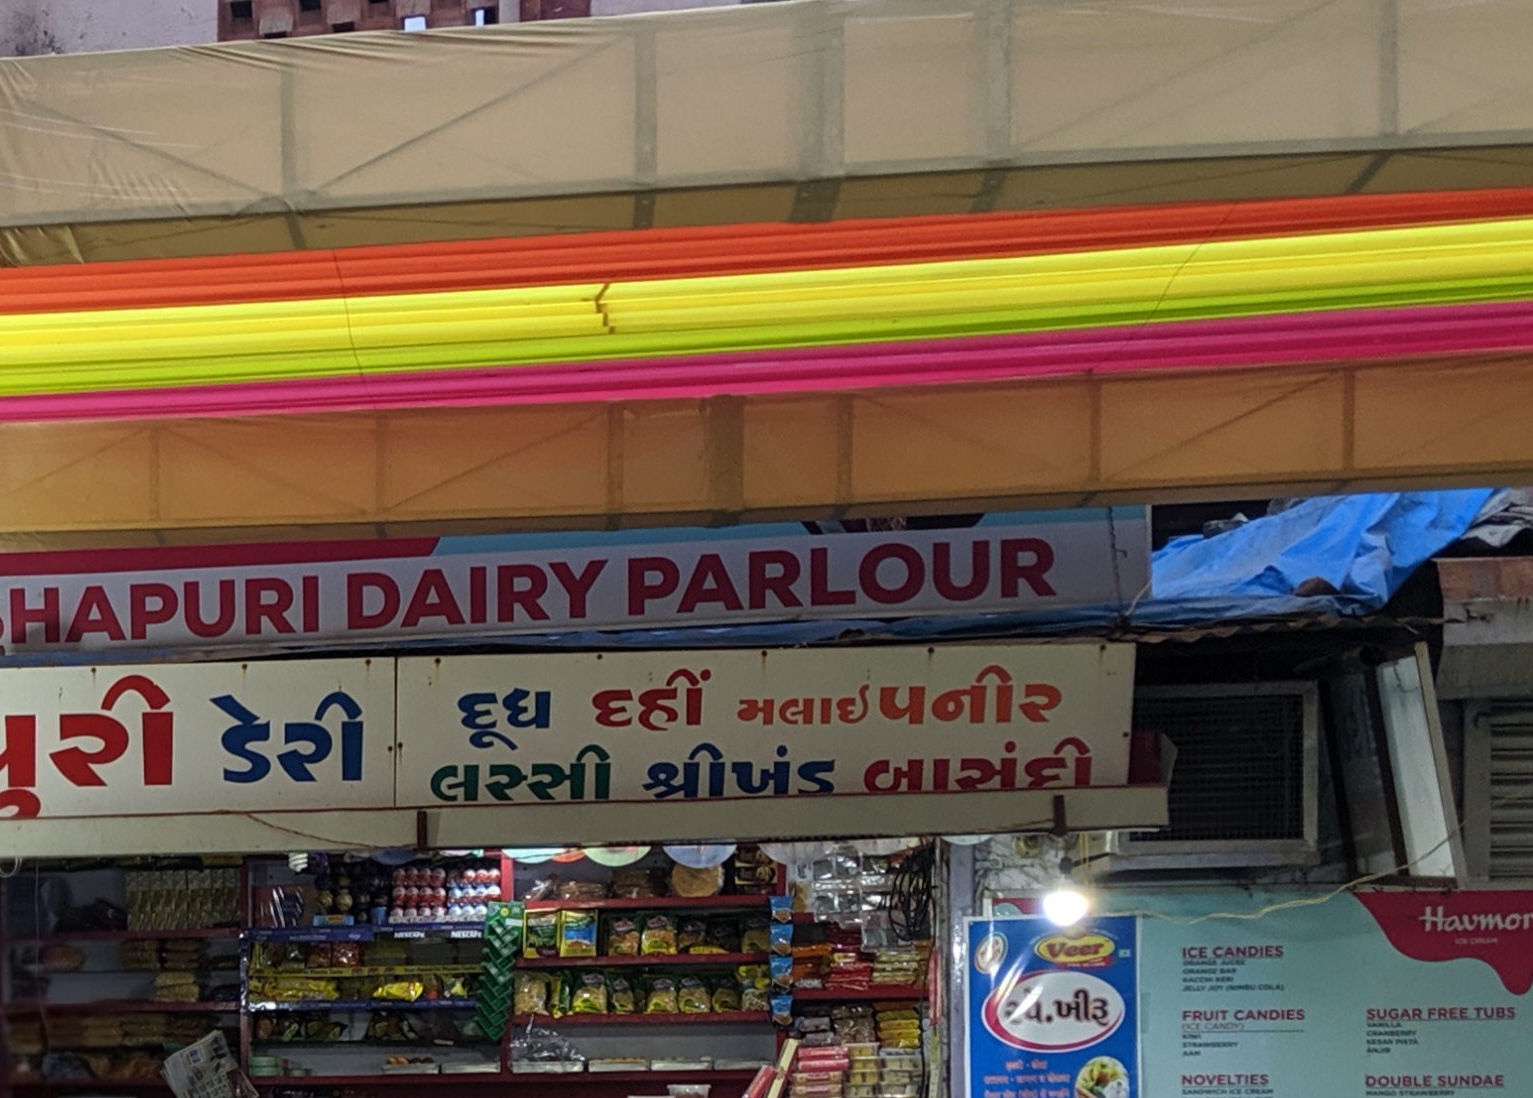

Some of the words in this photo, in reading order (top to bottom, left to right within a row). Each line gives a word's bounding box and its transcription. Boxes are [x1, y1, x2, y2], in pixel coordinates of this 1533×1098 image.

[346, 558, 608, 630] DAIRY
[627, 537, 1057, 616] PARLOUR
[457, 687, 551, 751] દૂધ
[592, 668, 712, 731] દહીં
[879, 665, 1062, 725] પનીર
[209, 691, 364, 783] ડેરી
[1418, 905, 1533, 932] Havmor
[1046, 943, 1104, 958] Veer
[1182, 947, 1208, 958] ICE
[1213, 946, 1284, 958] CANDIES
[1183, 1010, 1228, 1021] FRUIT
[1234, 1009, 1305, 1020] CANDIES
[1367, 1008, 1422, 1020] SUGAR
[1428, 1008, 1468, 1019] FREE
[1475, 1007, 1515, 1018] TUBS
[1182, 1023, 1200, 1032] (ICE
[1205, 1022, 1245, 1031] CANDY)
[1182, 1074, 1268, 1085] NOVELTIES
[1366, 1075, 1432, 1087] DOUBLE
[1438, 1075, 1504, 1086] SUNDAE
